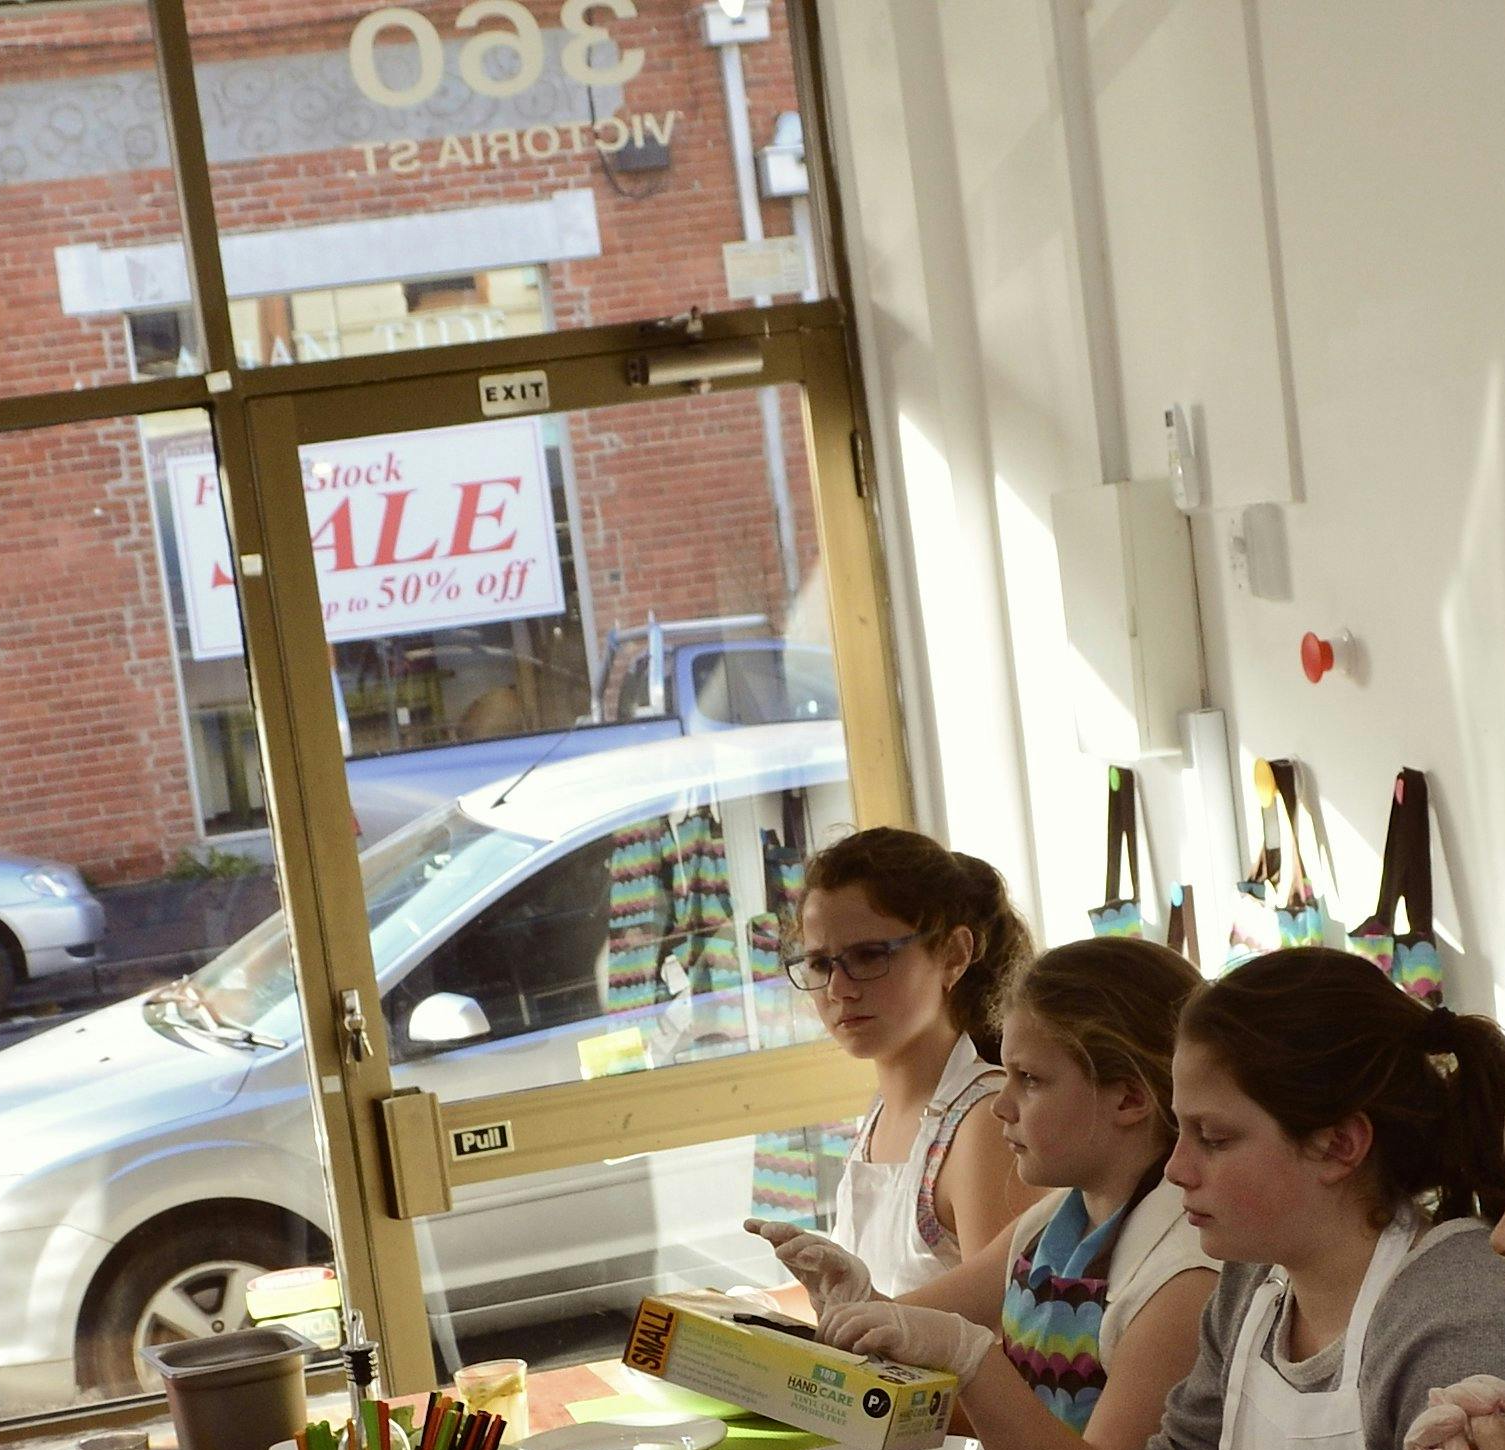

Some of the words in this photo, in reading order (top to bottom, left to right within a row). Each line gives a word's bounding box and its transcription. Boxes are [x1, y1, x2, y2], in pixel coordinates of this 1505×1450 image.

[175, 329, 342, 377] AIAN
[485, 382, 544, 403] EXIT
[376, 571, 462, 608] 50%
[476, 557, 536, 602] off
[460, 1127, 501, 1152] Pull
[631, 1310, 674, 1370] SMALL
[787, 1376, 818, 1397] HAND
[819, 1387, 854, 1407] CARE
